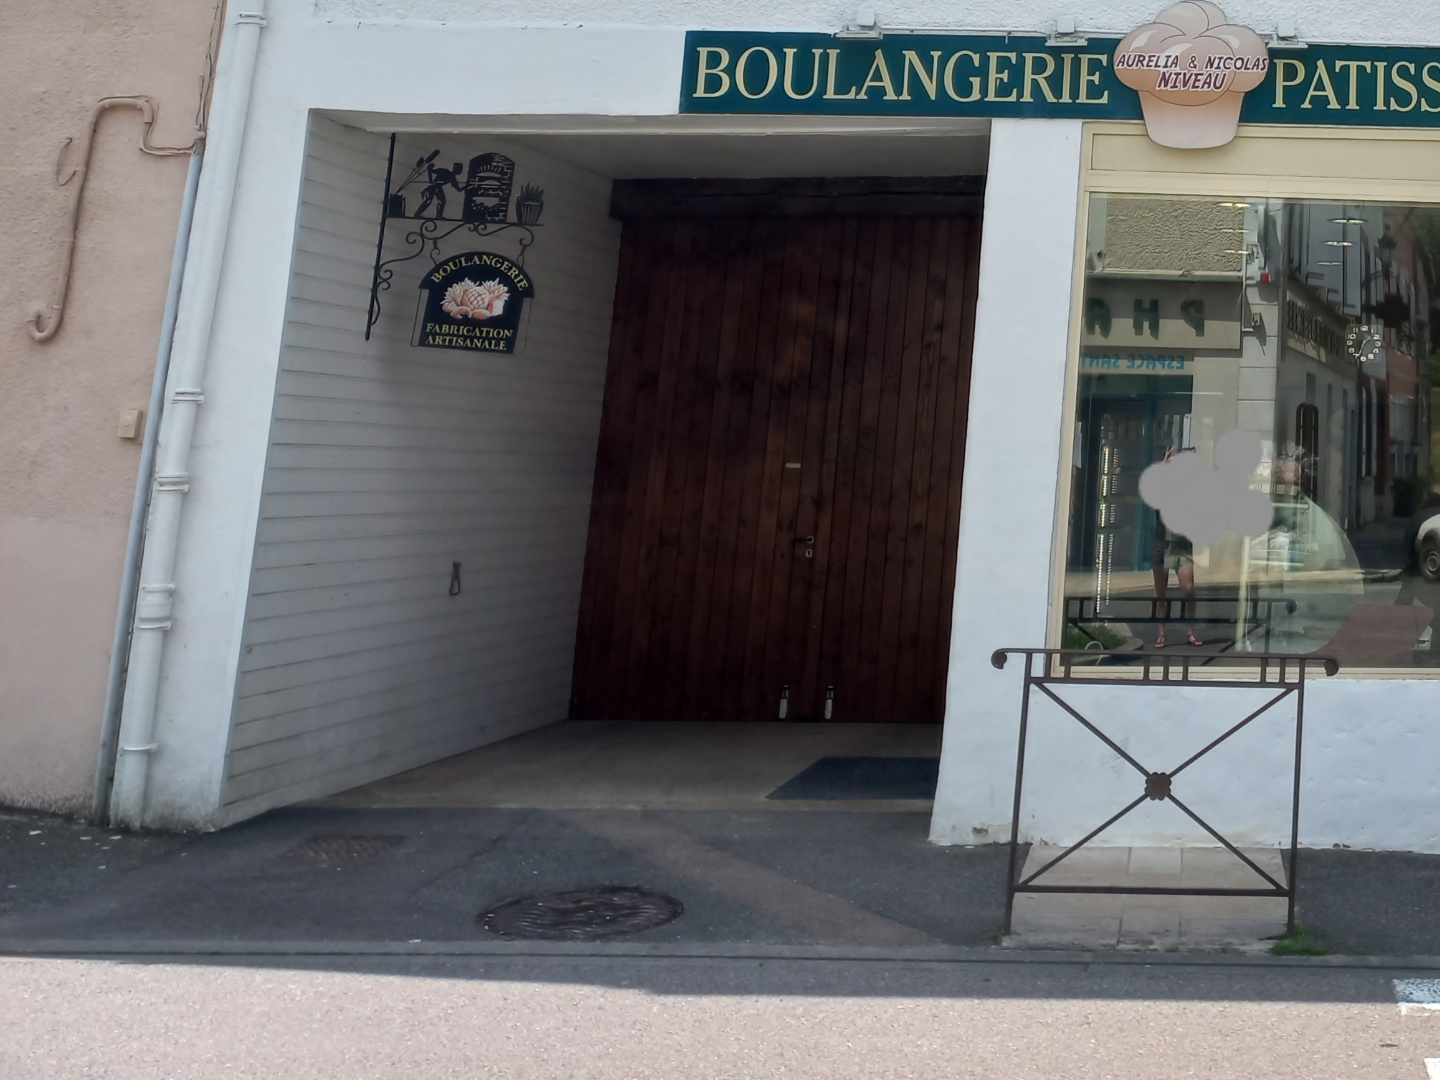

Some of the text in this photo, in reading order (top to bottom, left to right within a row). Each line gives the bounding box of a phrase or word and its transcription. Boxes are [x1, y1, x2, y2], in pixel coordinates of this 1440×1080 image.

[1116, 53, 1268, 71] AURELIA & NICOLAS
[692, 46, 1109, 104] BOULANGERIE
[1157, 71, 1227, 90] NIVEAU
[431, 255, 528, 291] BOULANGERIE
[425, 322, 513, 339] FABRICATION
[425, 335, 507, 350] ARTISANALE
